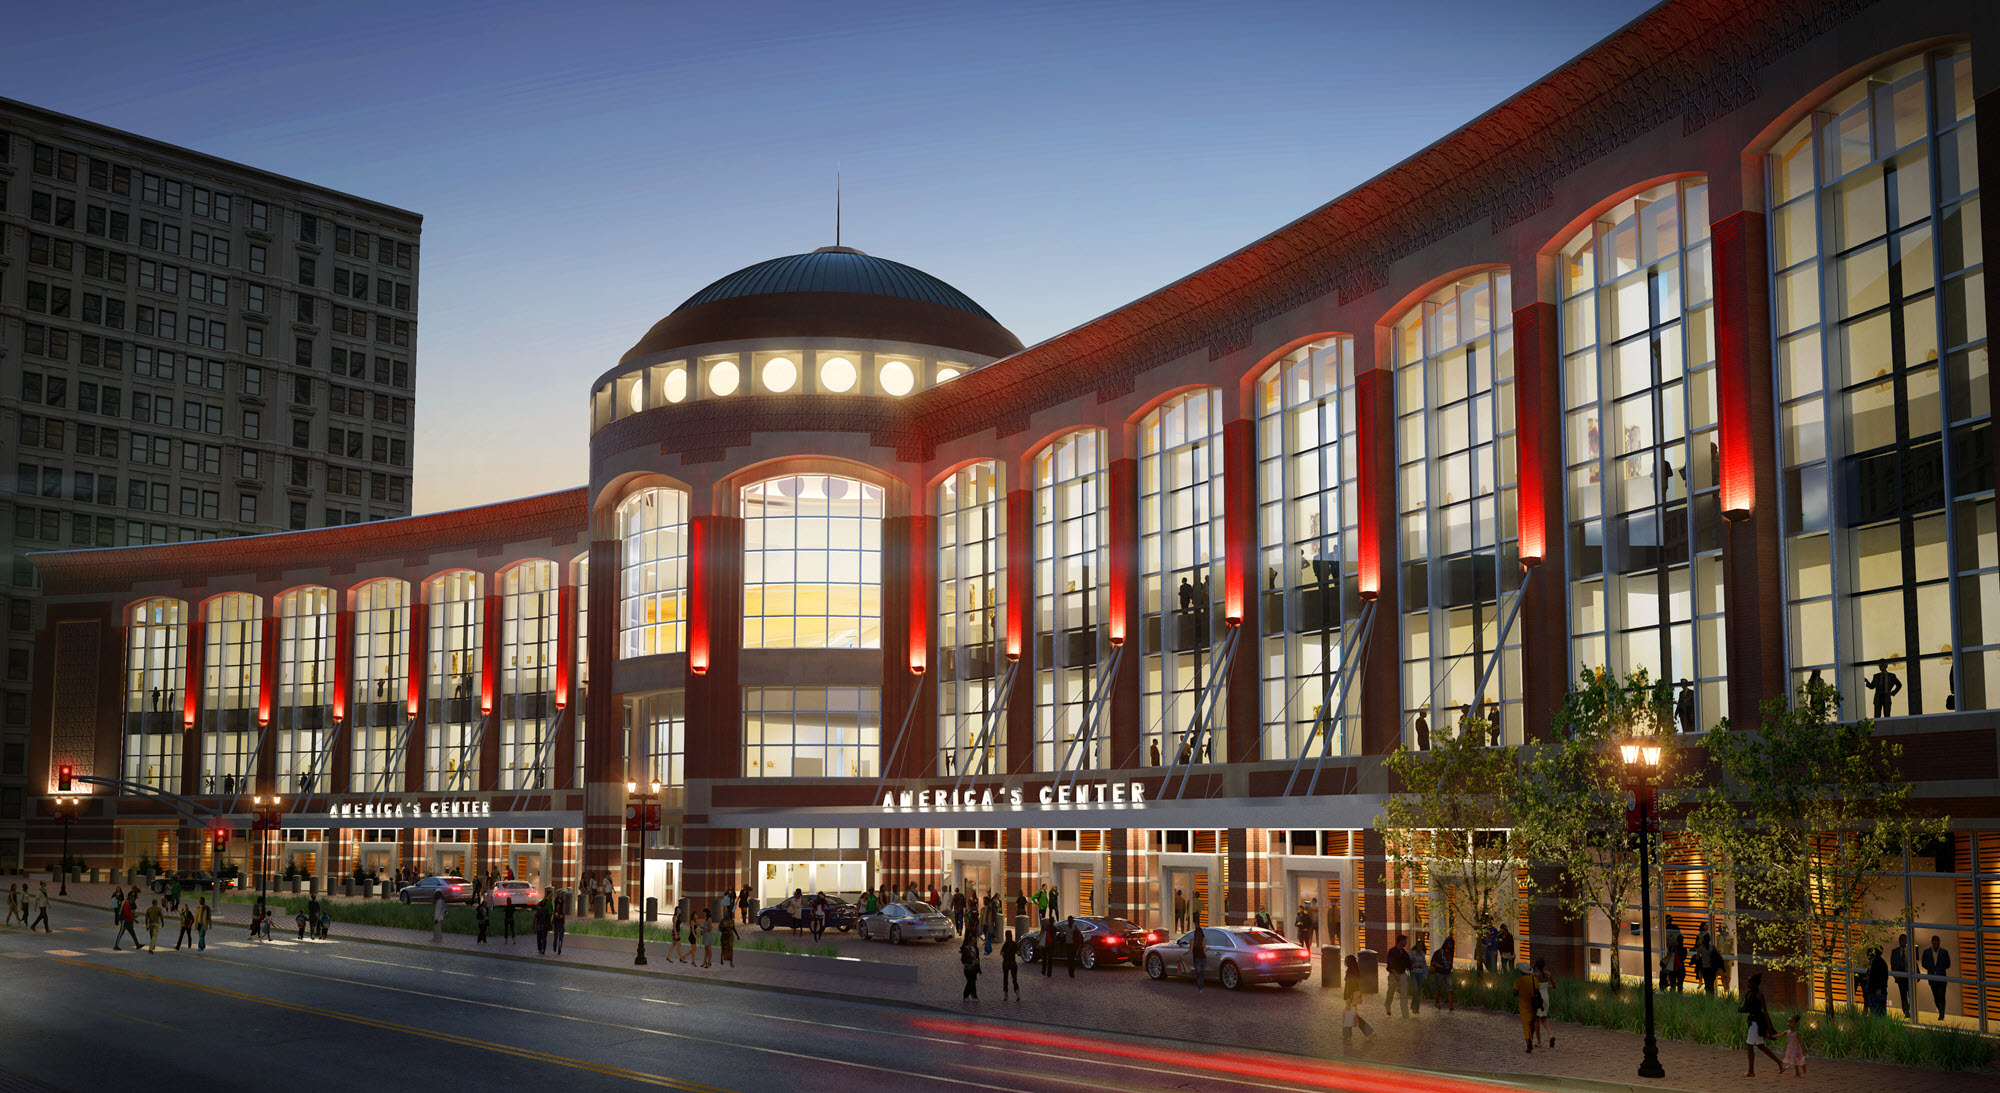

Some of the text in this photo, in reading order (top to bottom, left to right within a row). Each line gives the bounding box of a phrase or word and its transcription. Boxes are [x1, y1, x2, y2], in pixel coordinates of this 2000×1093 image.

[882, 782, 1145, 807] AMERICA'S CENTER
[330, 801, 491, 815] AMERICA'S CENTER
